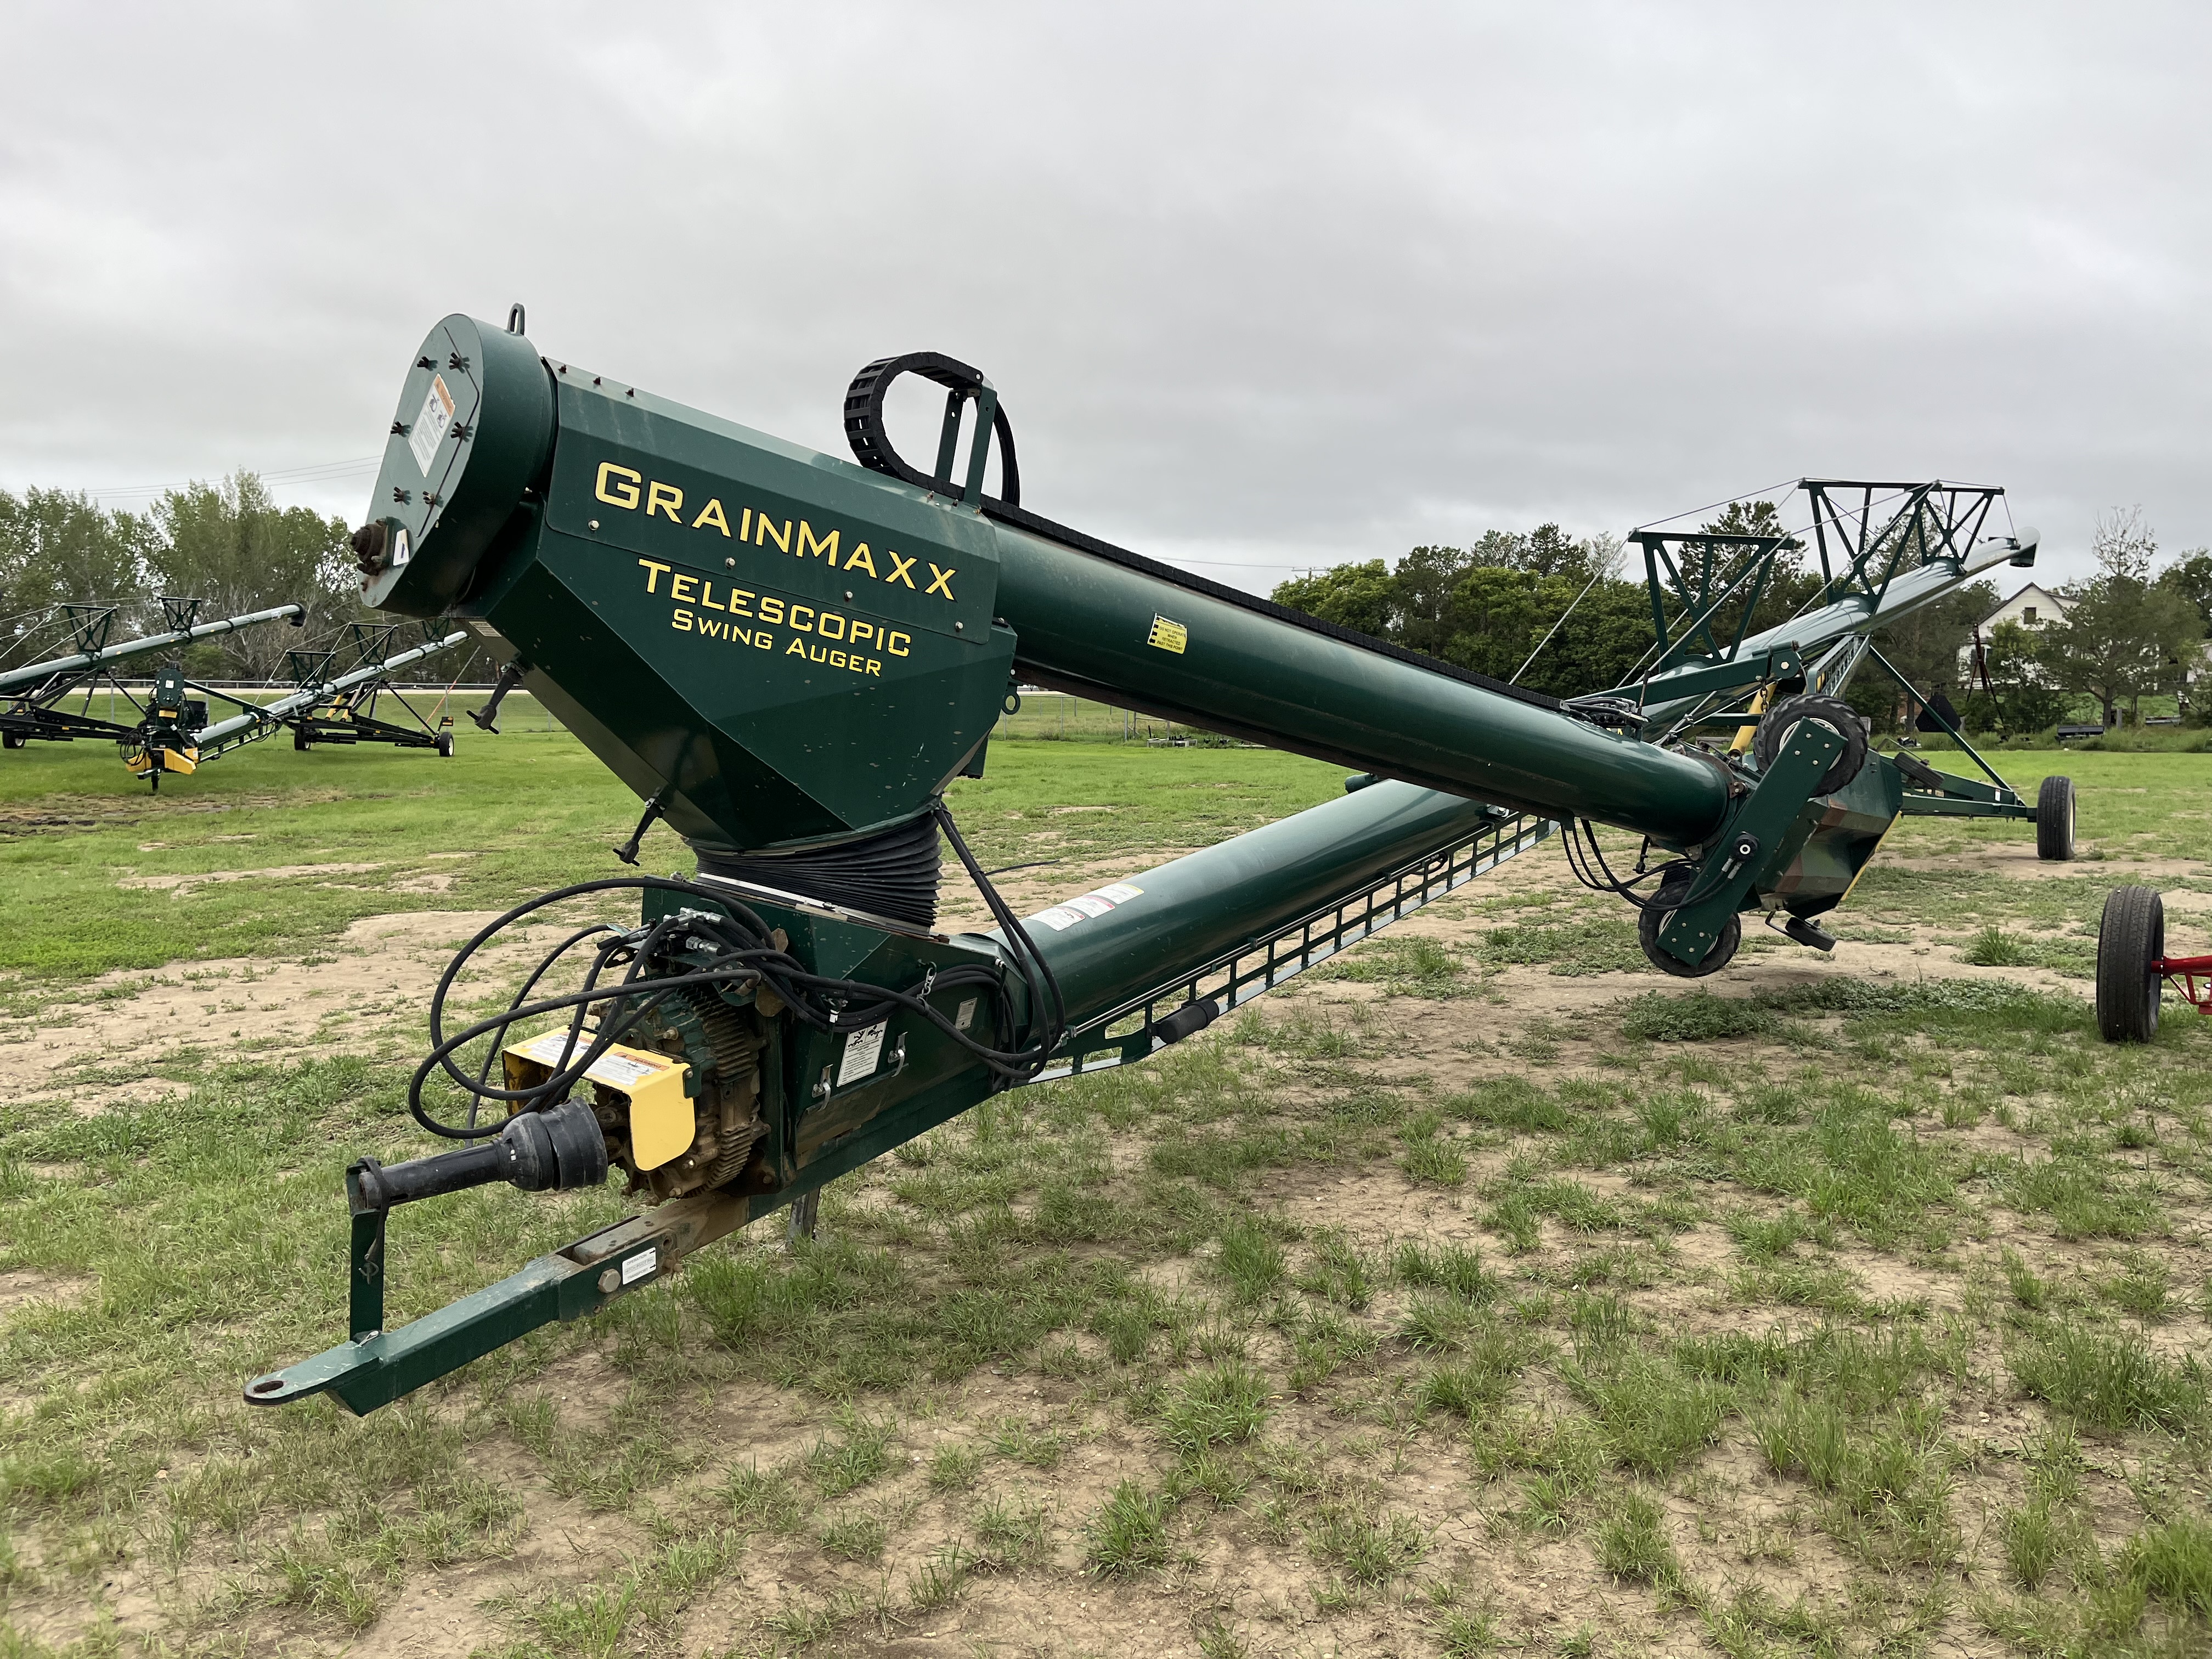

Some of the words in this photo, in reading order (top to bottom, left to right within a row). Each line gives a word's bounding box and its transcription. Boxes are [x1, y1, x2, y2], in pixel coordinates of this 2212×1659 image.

[596, 462, 956, 600] GRAINMAXX
[639, 558, 911, 657] TELESCOPIC
[672, 609, 774, 650] SWING
[786, 637, 882, 677] AUGER
[1162, 637, 1181, 645] RETRACTED
[634, 1058, 662, 1068] WARNING
[627, 1254, 647, 1266] OPERATION
[627, 1268, 648, 1279] TRANSPORT
